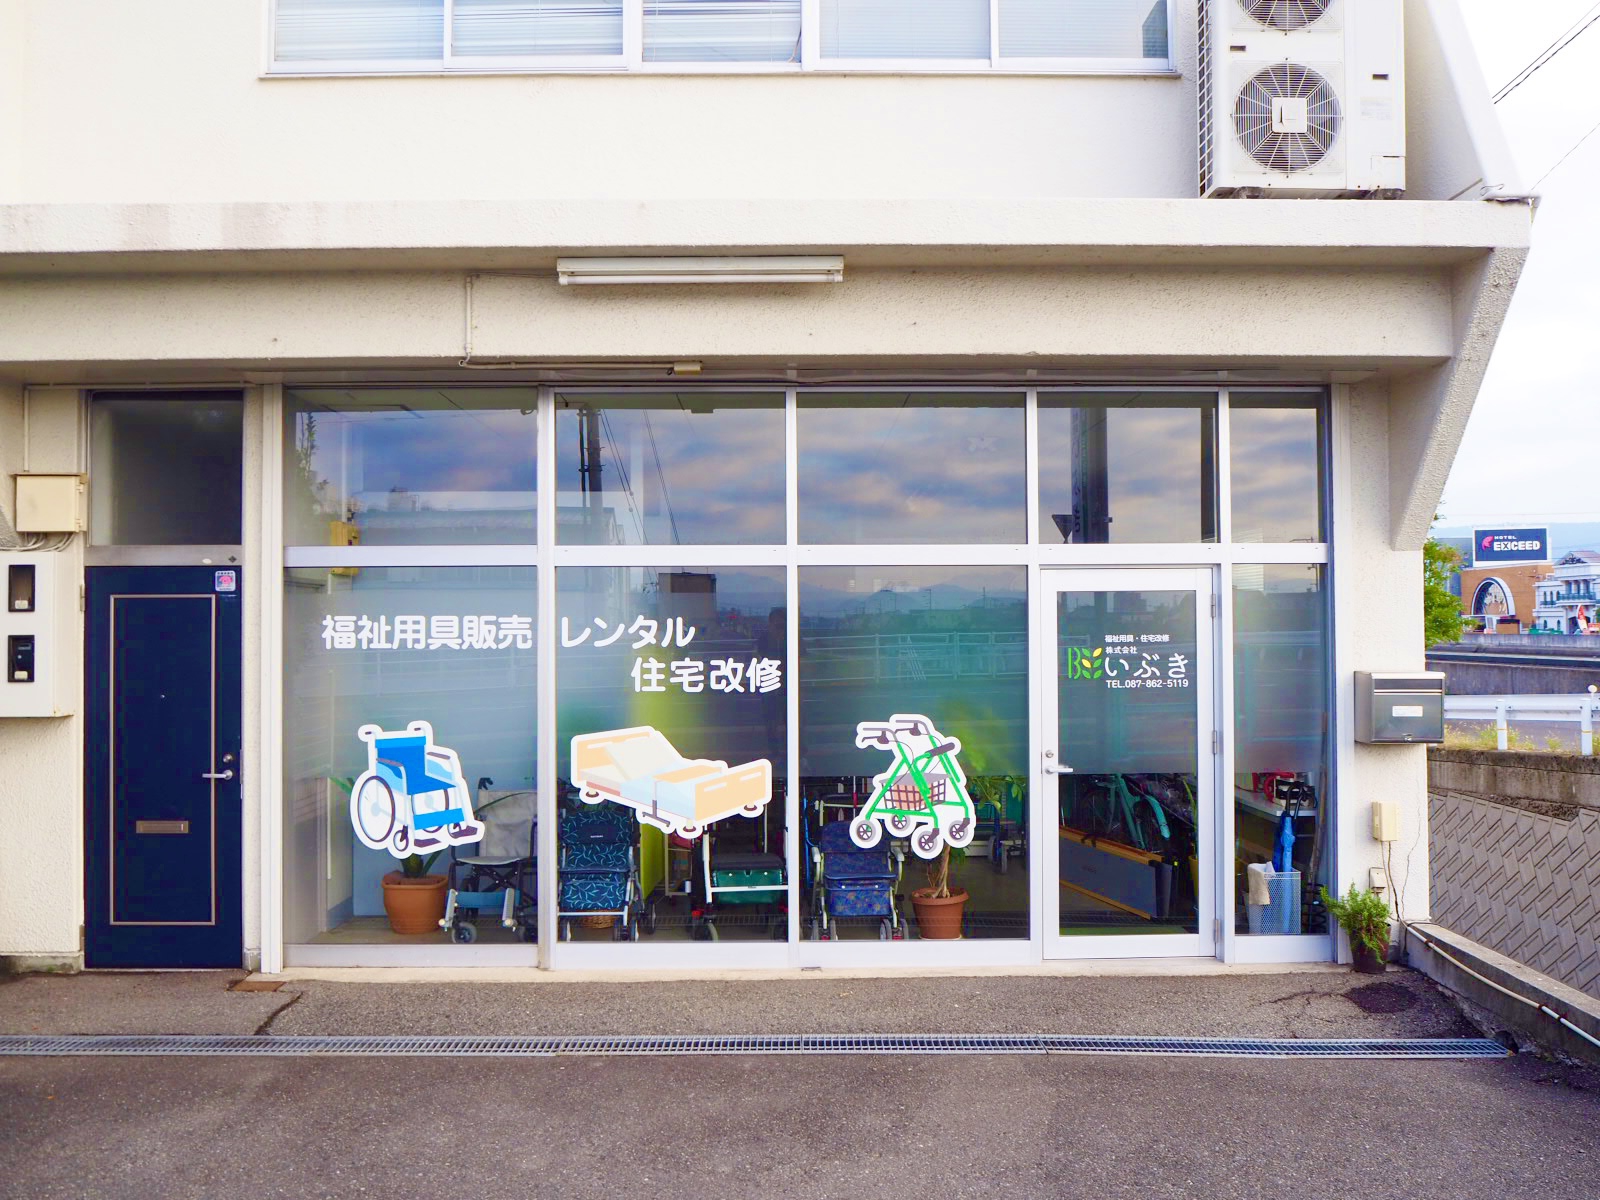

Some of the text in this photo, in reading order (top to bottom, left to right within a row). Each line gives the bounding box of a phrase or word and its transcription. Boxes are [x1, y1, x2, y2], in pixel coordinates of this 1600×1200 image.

[1493, 540, 1541, 551] EXCEED
[321, 614, 696, 650] 福祉用具販売 レンタル
[1105, 646, 1138, 654] 株式会社
[630, 656, 782, 693] 住宅改修
[1104, 653, 1189, 678] いぶき
[1106, 679, 1189, 689] TEL.087-862-5119
